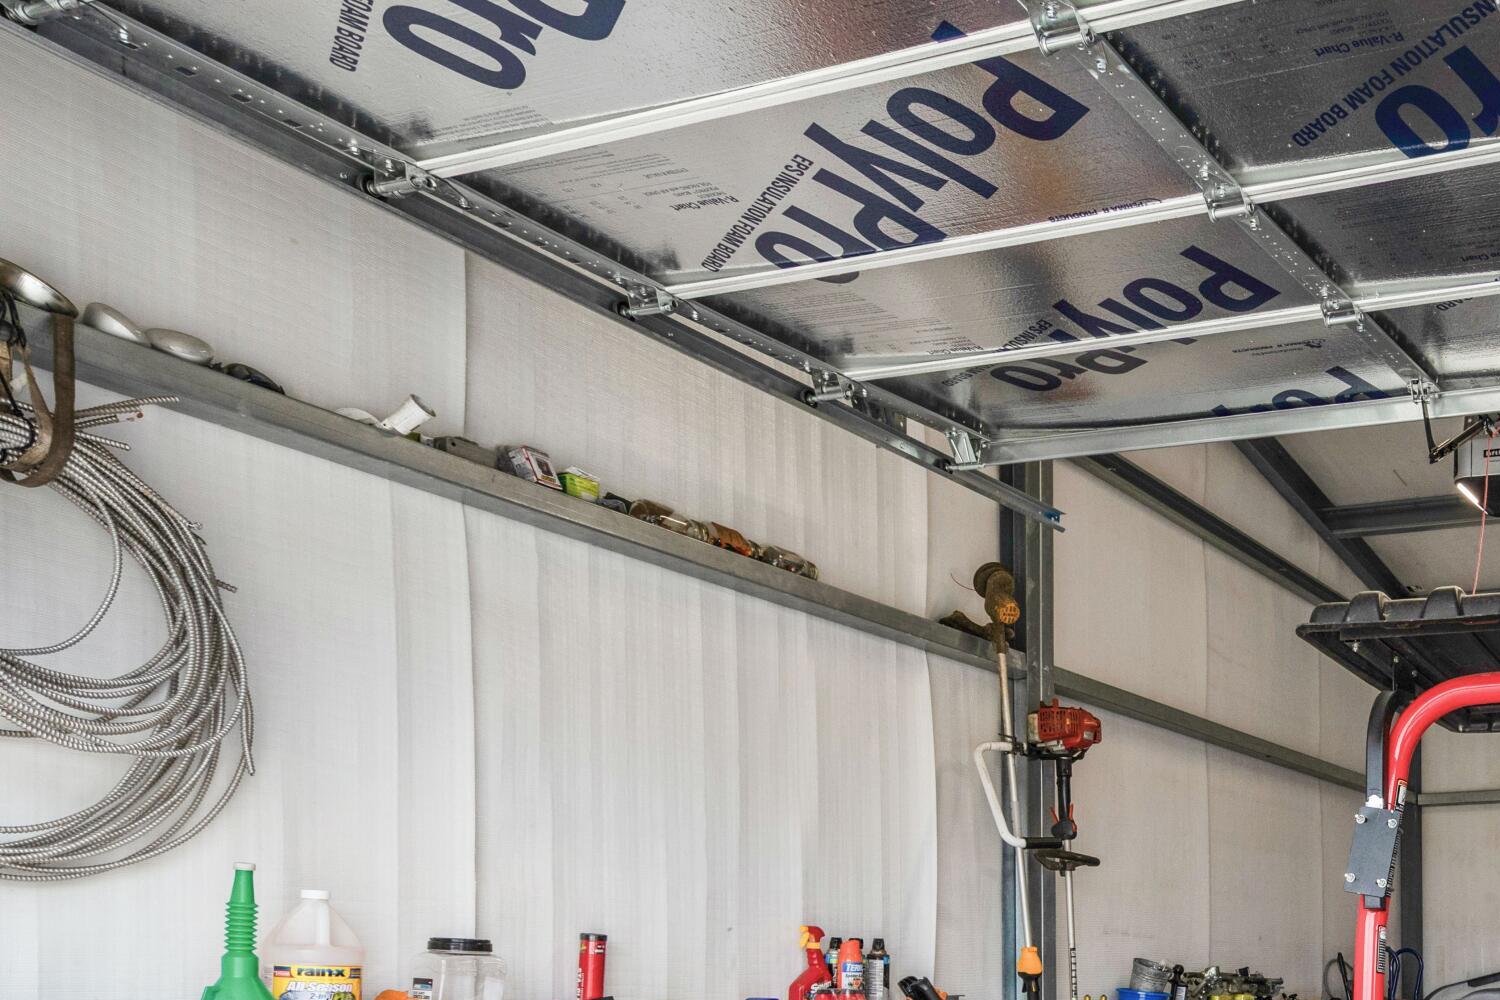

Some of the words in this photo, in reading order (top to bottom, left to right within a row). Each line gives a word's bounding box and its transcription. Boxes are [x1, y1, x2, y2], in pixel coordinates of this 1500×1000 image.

[329, 26, 364, 72] BOARD
[1314, 43, 1350, 57] Chart
[1391, 0, 1496, 77] NSULATION
[1343, 70, 1393, 110] FOAM
[1292, 104, 1349, 147] BOARD
[784, 154, 814, 178] EPS
[741, 171, 799, 225] INSULATION
[722, 220, 755, 248] FOAM
[701, 243, 736, 272] BOARD
